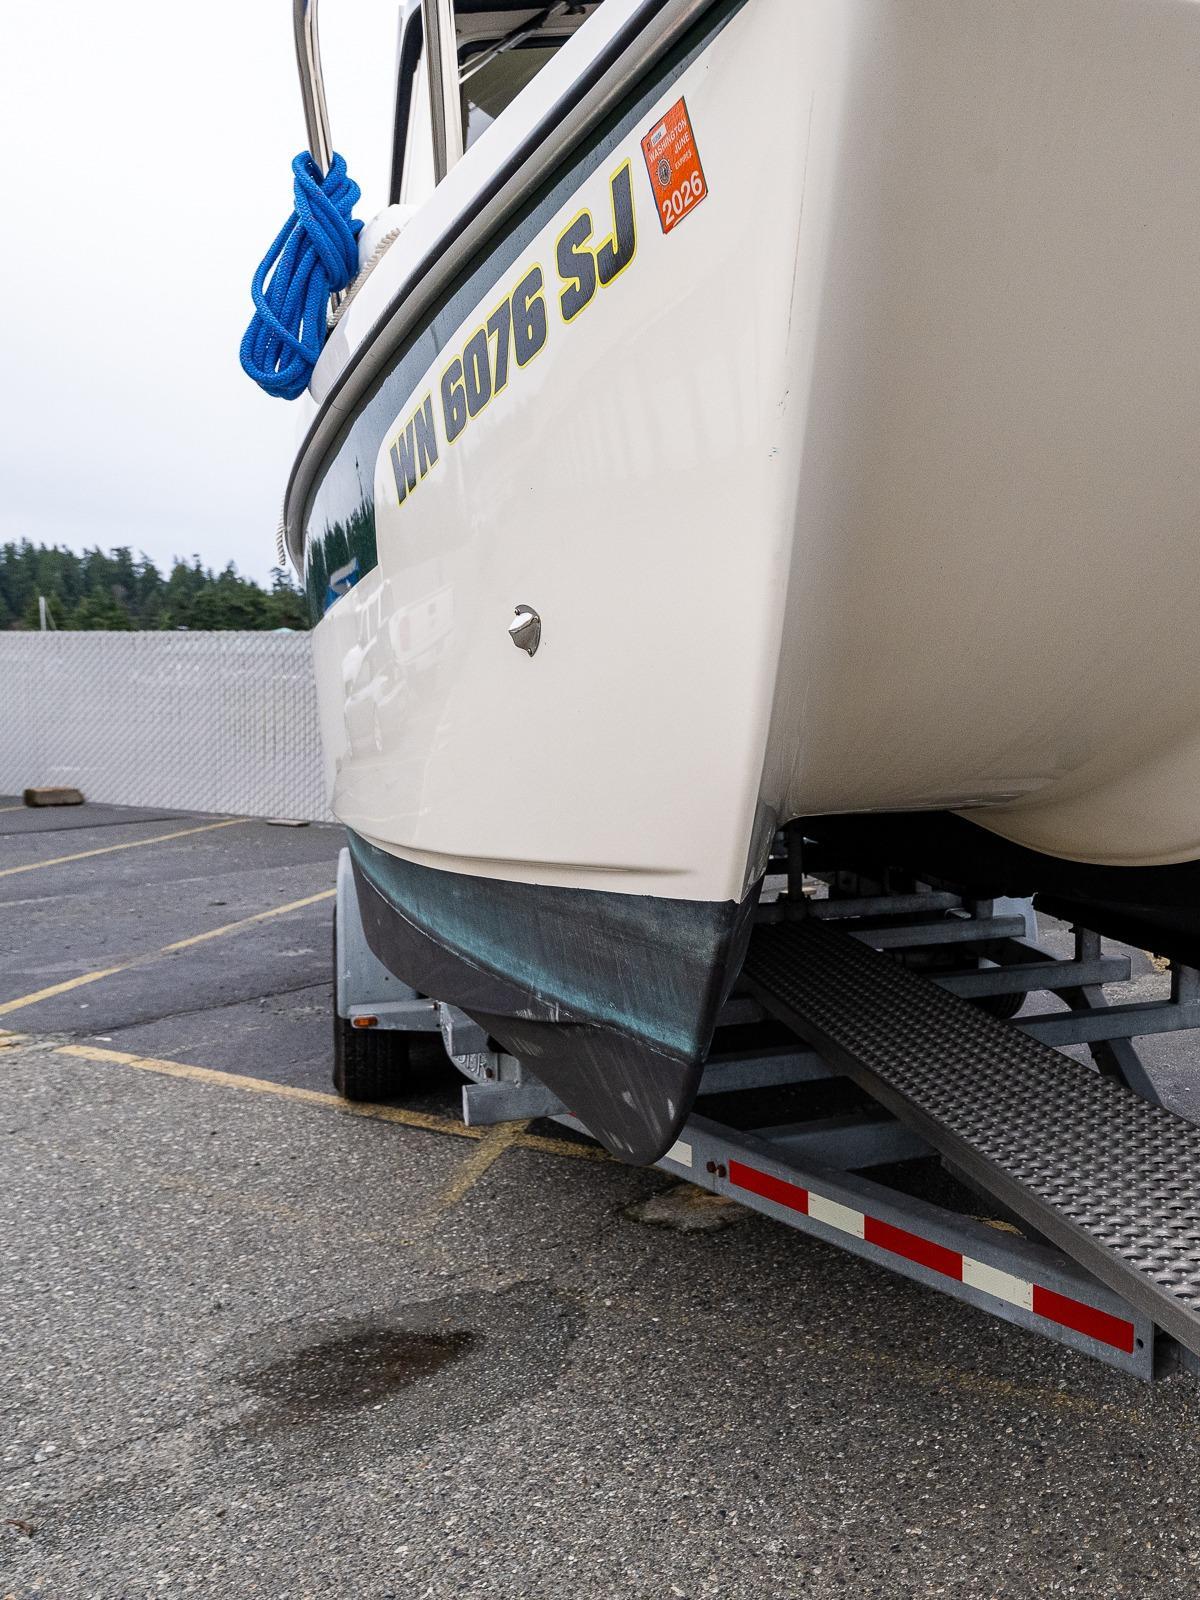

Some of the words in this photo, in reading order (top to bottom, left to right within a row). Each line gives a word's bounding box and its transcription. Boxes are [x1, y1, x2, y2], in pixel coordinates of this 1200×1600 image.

[648, 119, 687, 162] WASHINGTON
[674, 132, 690, 154] JUNE
[662, 170, 702, 225] 2026
[388, 389, 440, 507] WN
[440, 262, 549, 446] 6076
[555, 157, 639, 324] SJ
